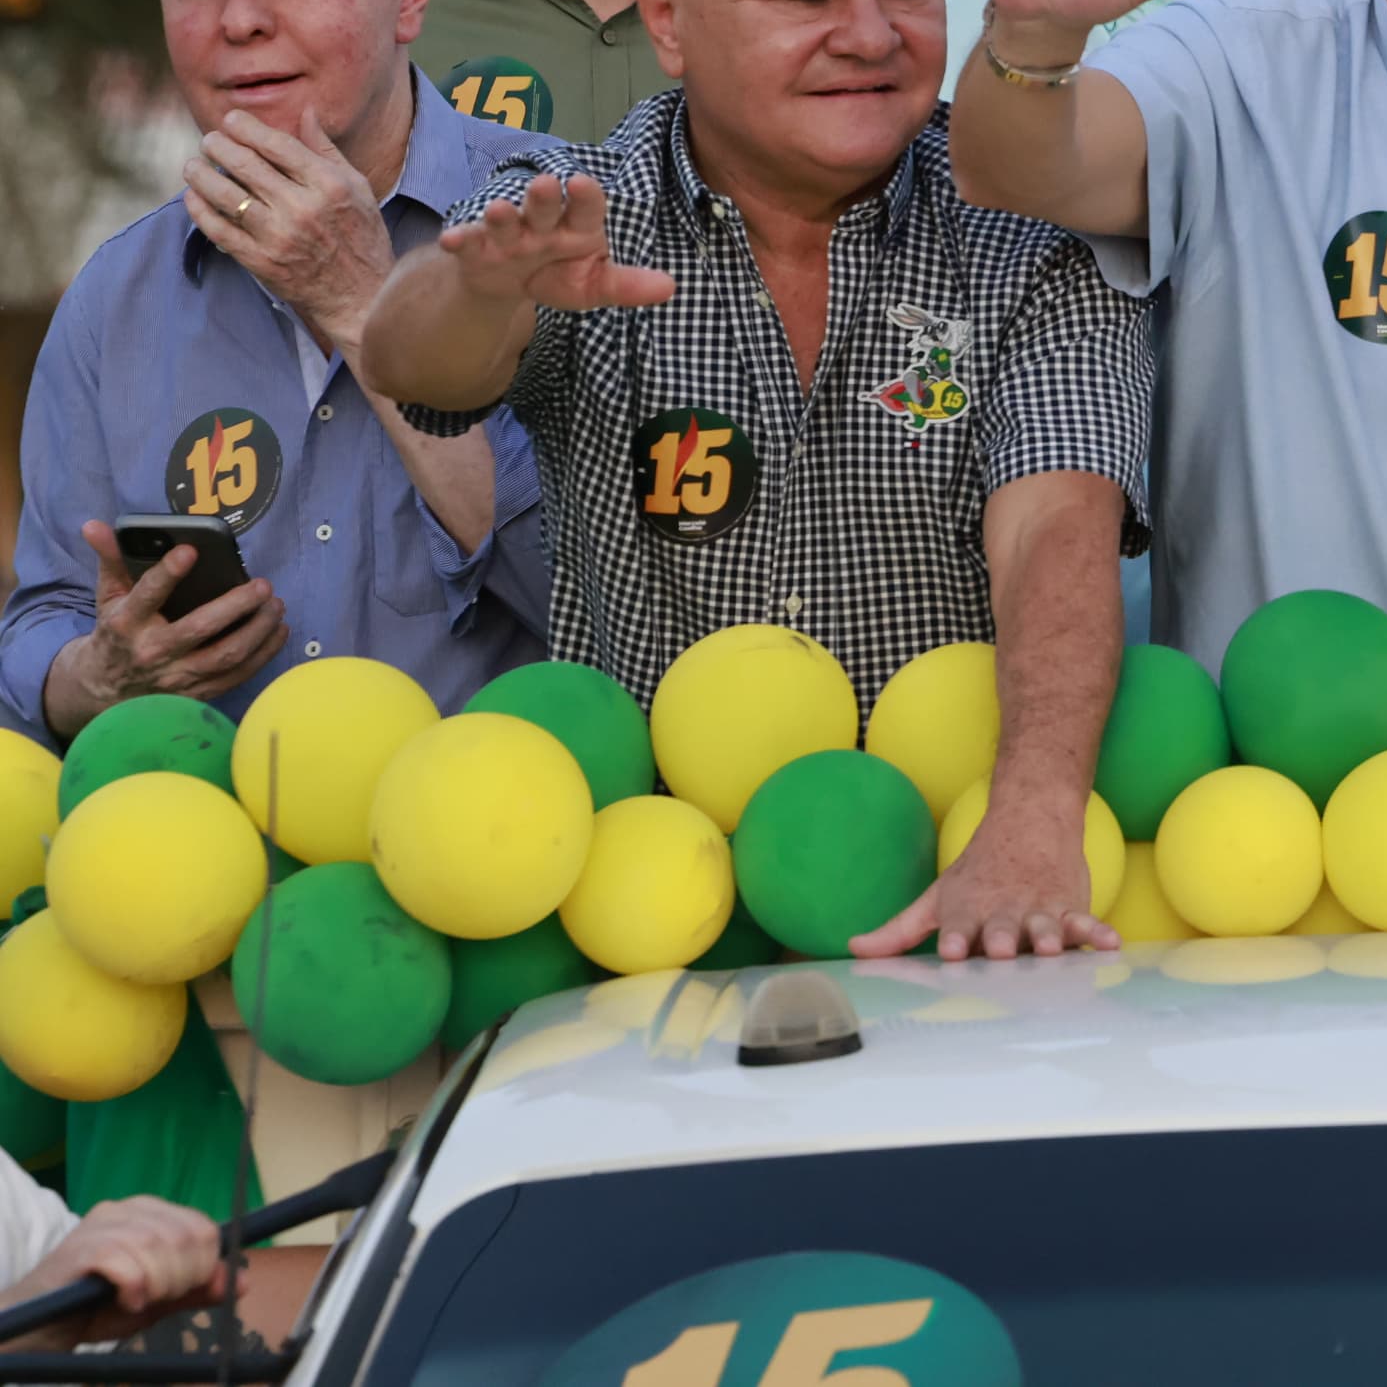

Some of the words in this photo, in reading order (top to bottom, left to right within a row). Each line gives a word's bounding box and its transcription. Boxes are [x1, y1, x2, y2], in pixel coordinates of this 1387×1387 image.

[450, 75, 533, 130] 15
[943, 392, 963, 408] 15
[186, 418, 257, 515] 15
[644, 428, 733, 515] 15
